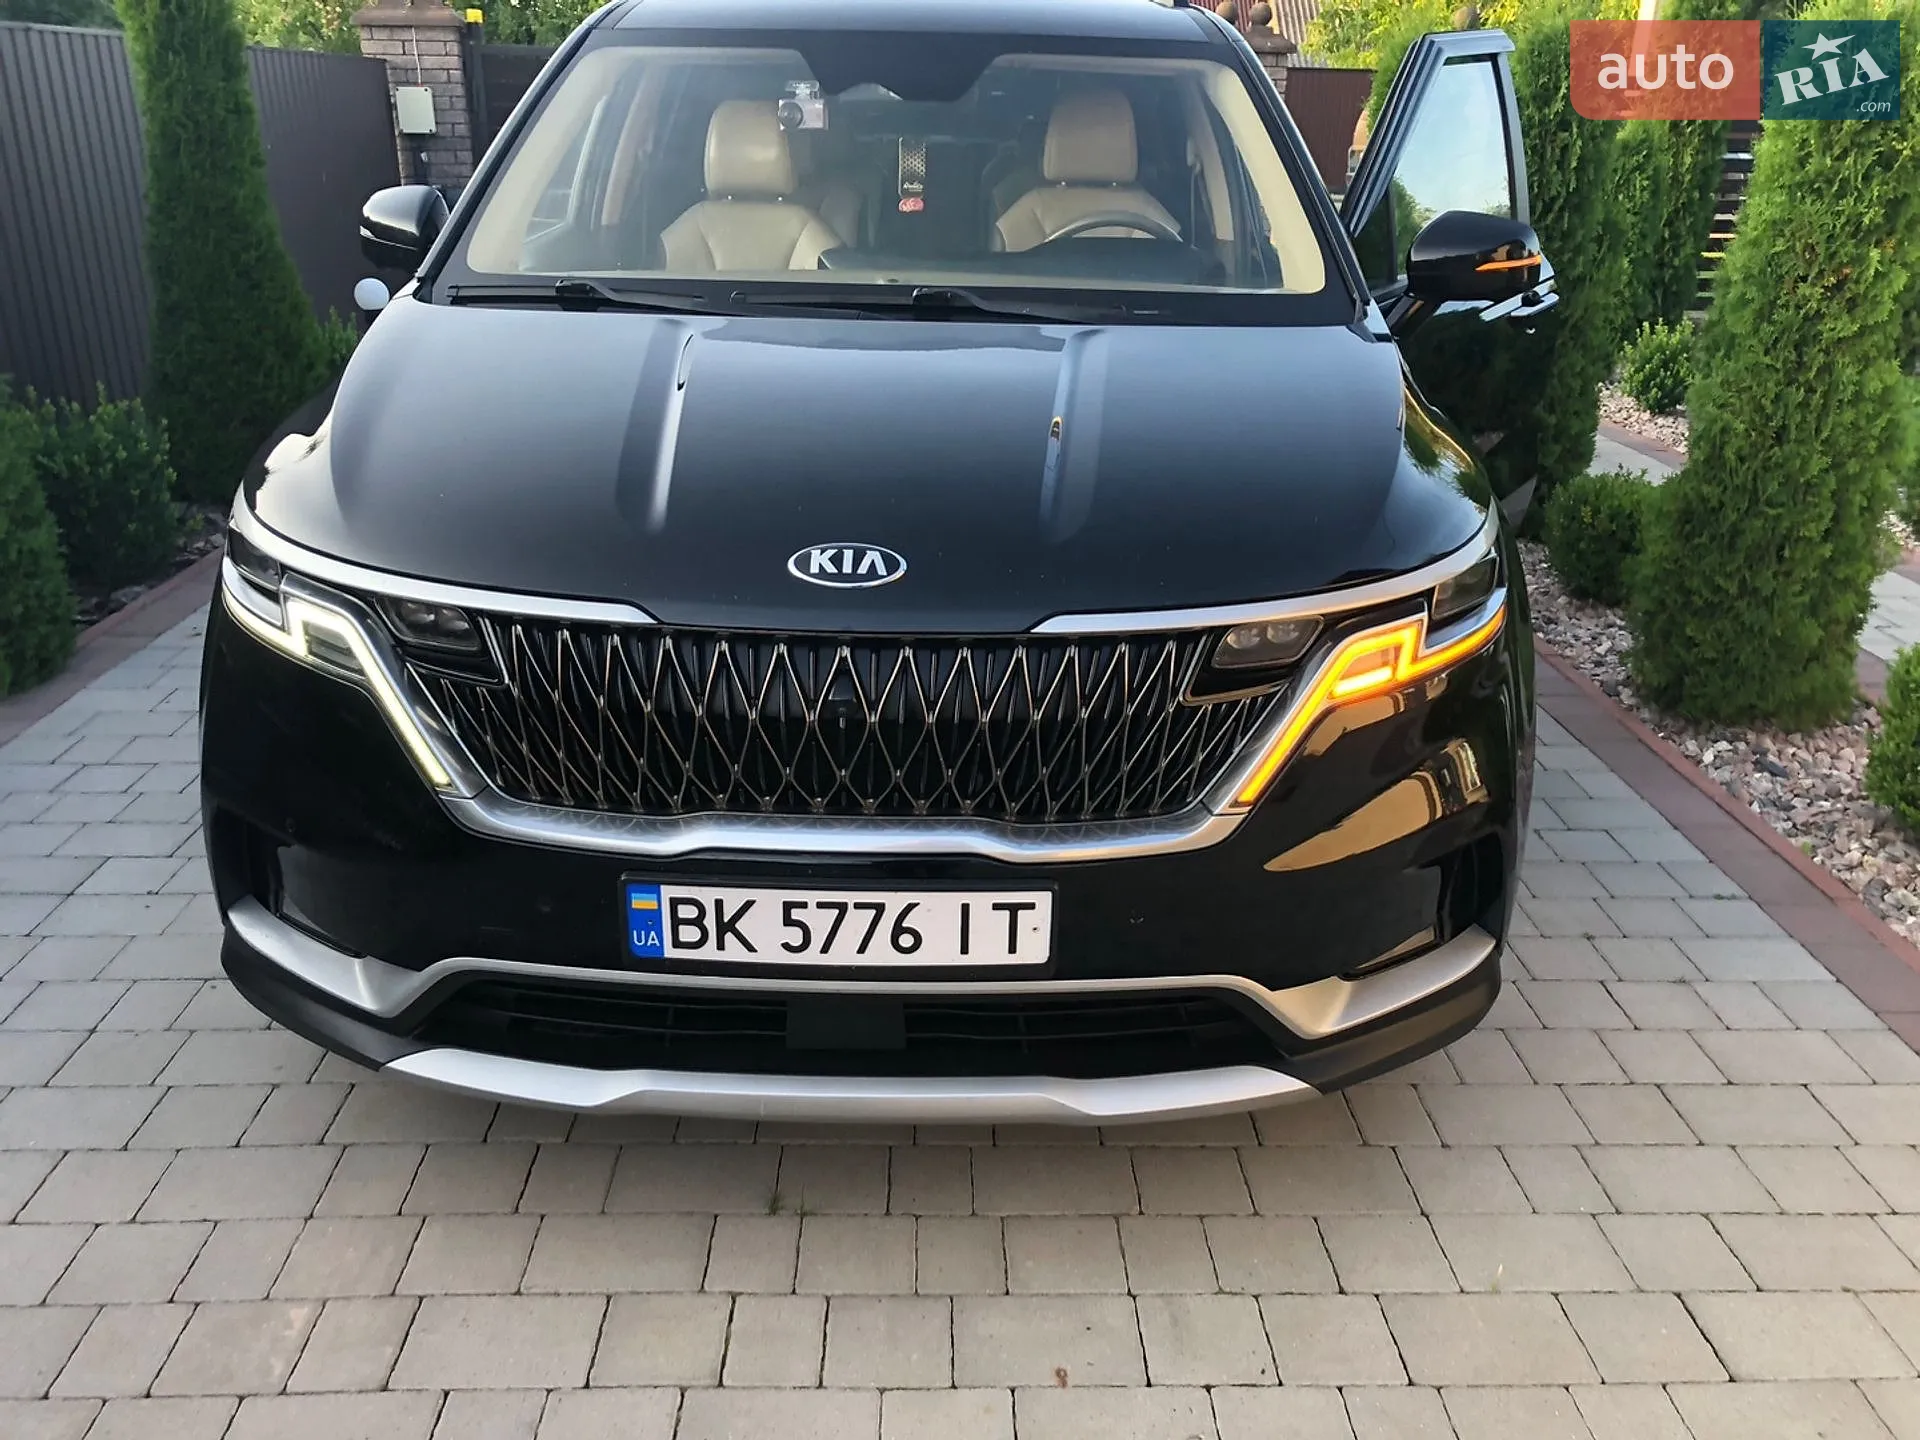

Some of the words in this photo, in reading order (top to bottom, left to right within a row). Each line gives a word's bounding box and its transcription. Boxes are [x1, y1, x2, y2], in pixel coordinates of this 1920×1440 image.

[809, 549, 887, 576] KIA
[632, 930, 660, 947] UA
[668, 896, 758, 953] BK
[780, 901, 922, 955] 5776
